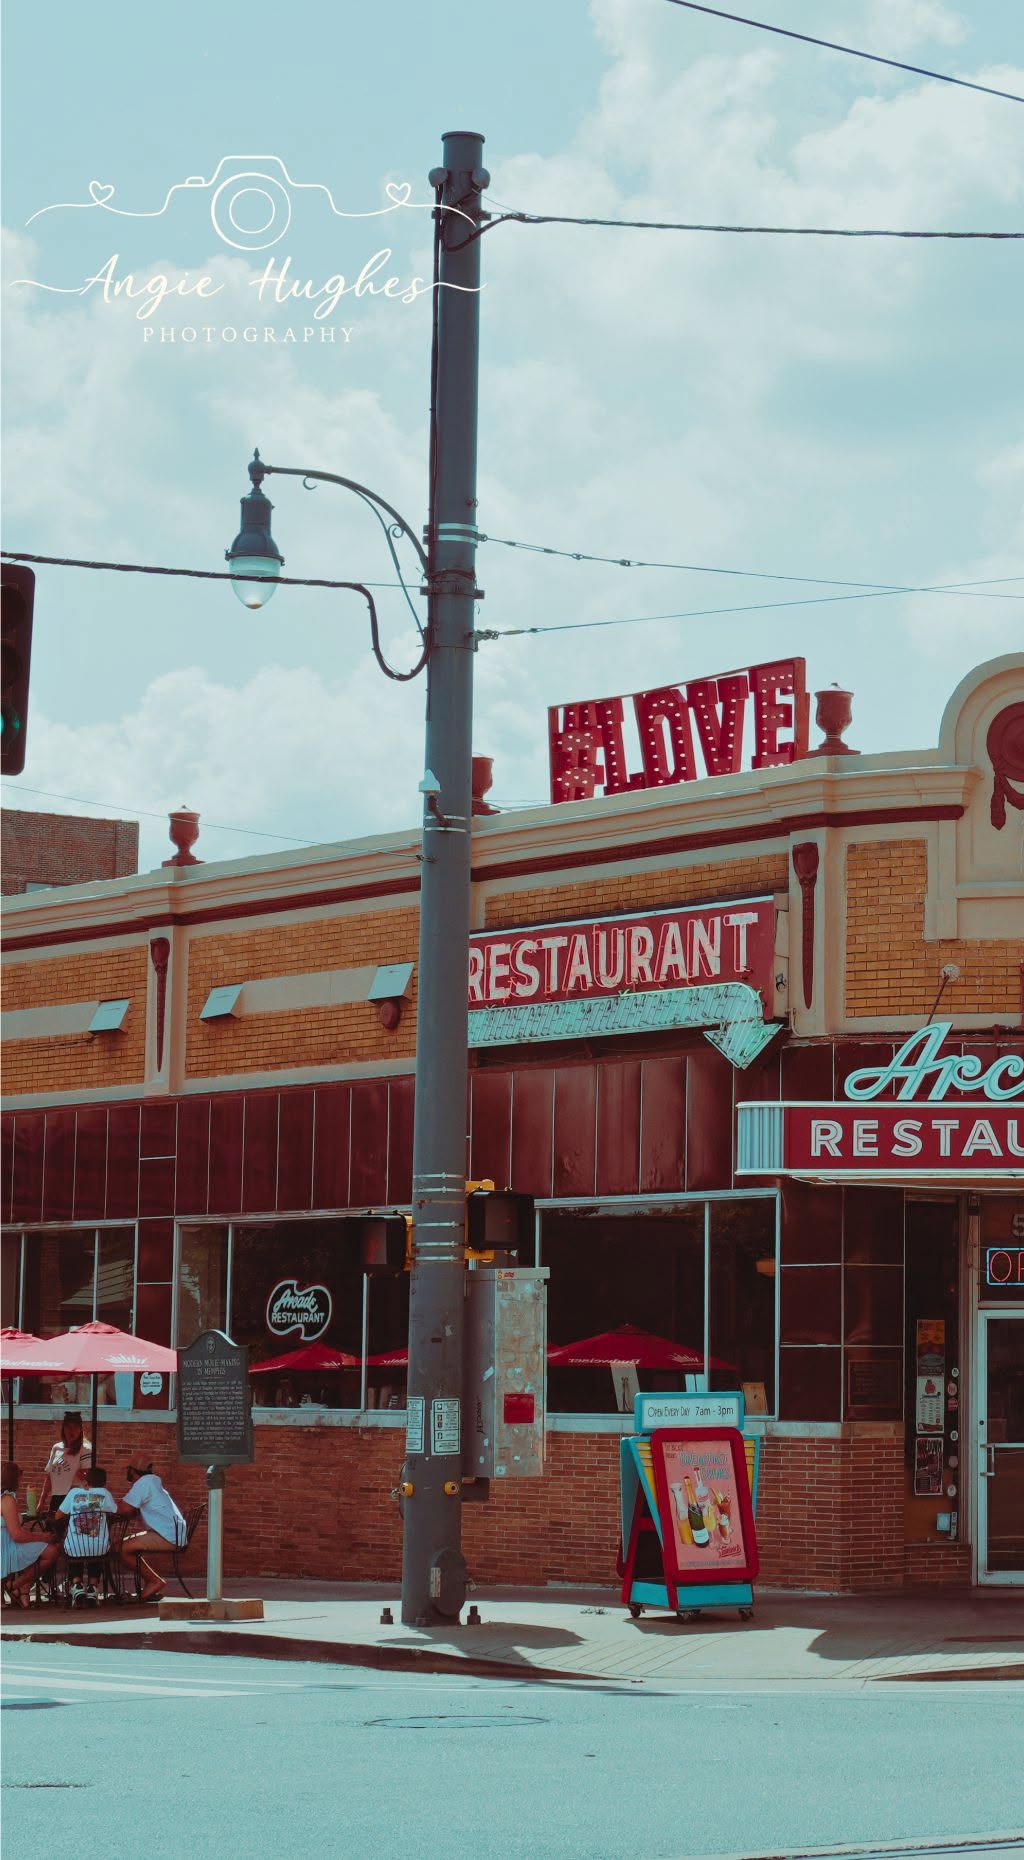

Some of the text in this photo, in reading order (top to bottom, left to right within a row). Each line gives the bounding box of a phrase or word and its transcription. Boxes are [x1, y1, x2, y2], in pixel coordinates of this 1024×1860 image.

[468, 911, 759, 1002] RESTAURANT
[273, 1288, 319, 1313] Arcade
[271, 1311, 326, 1323] RESTAURANT
[695, 1406, 711, 1416] 7am
[718, 1405, 734, 1417] 3pm
